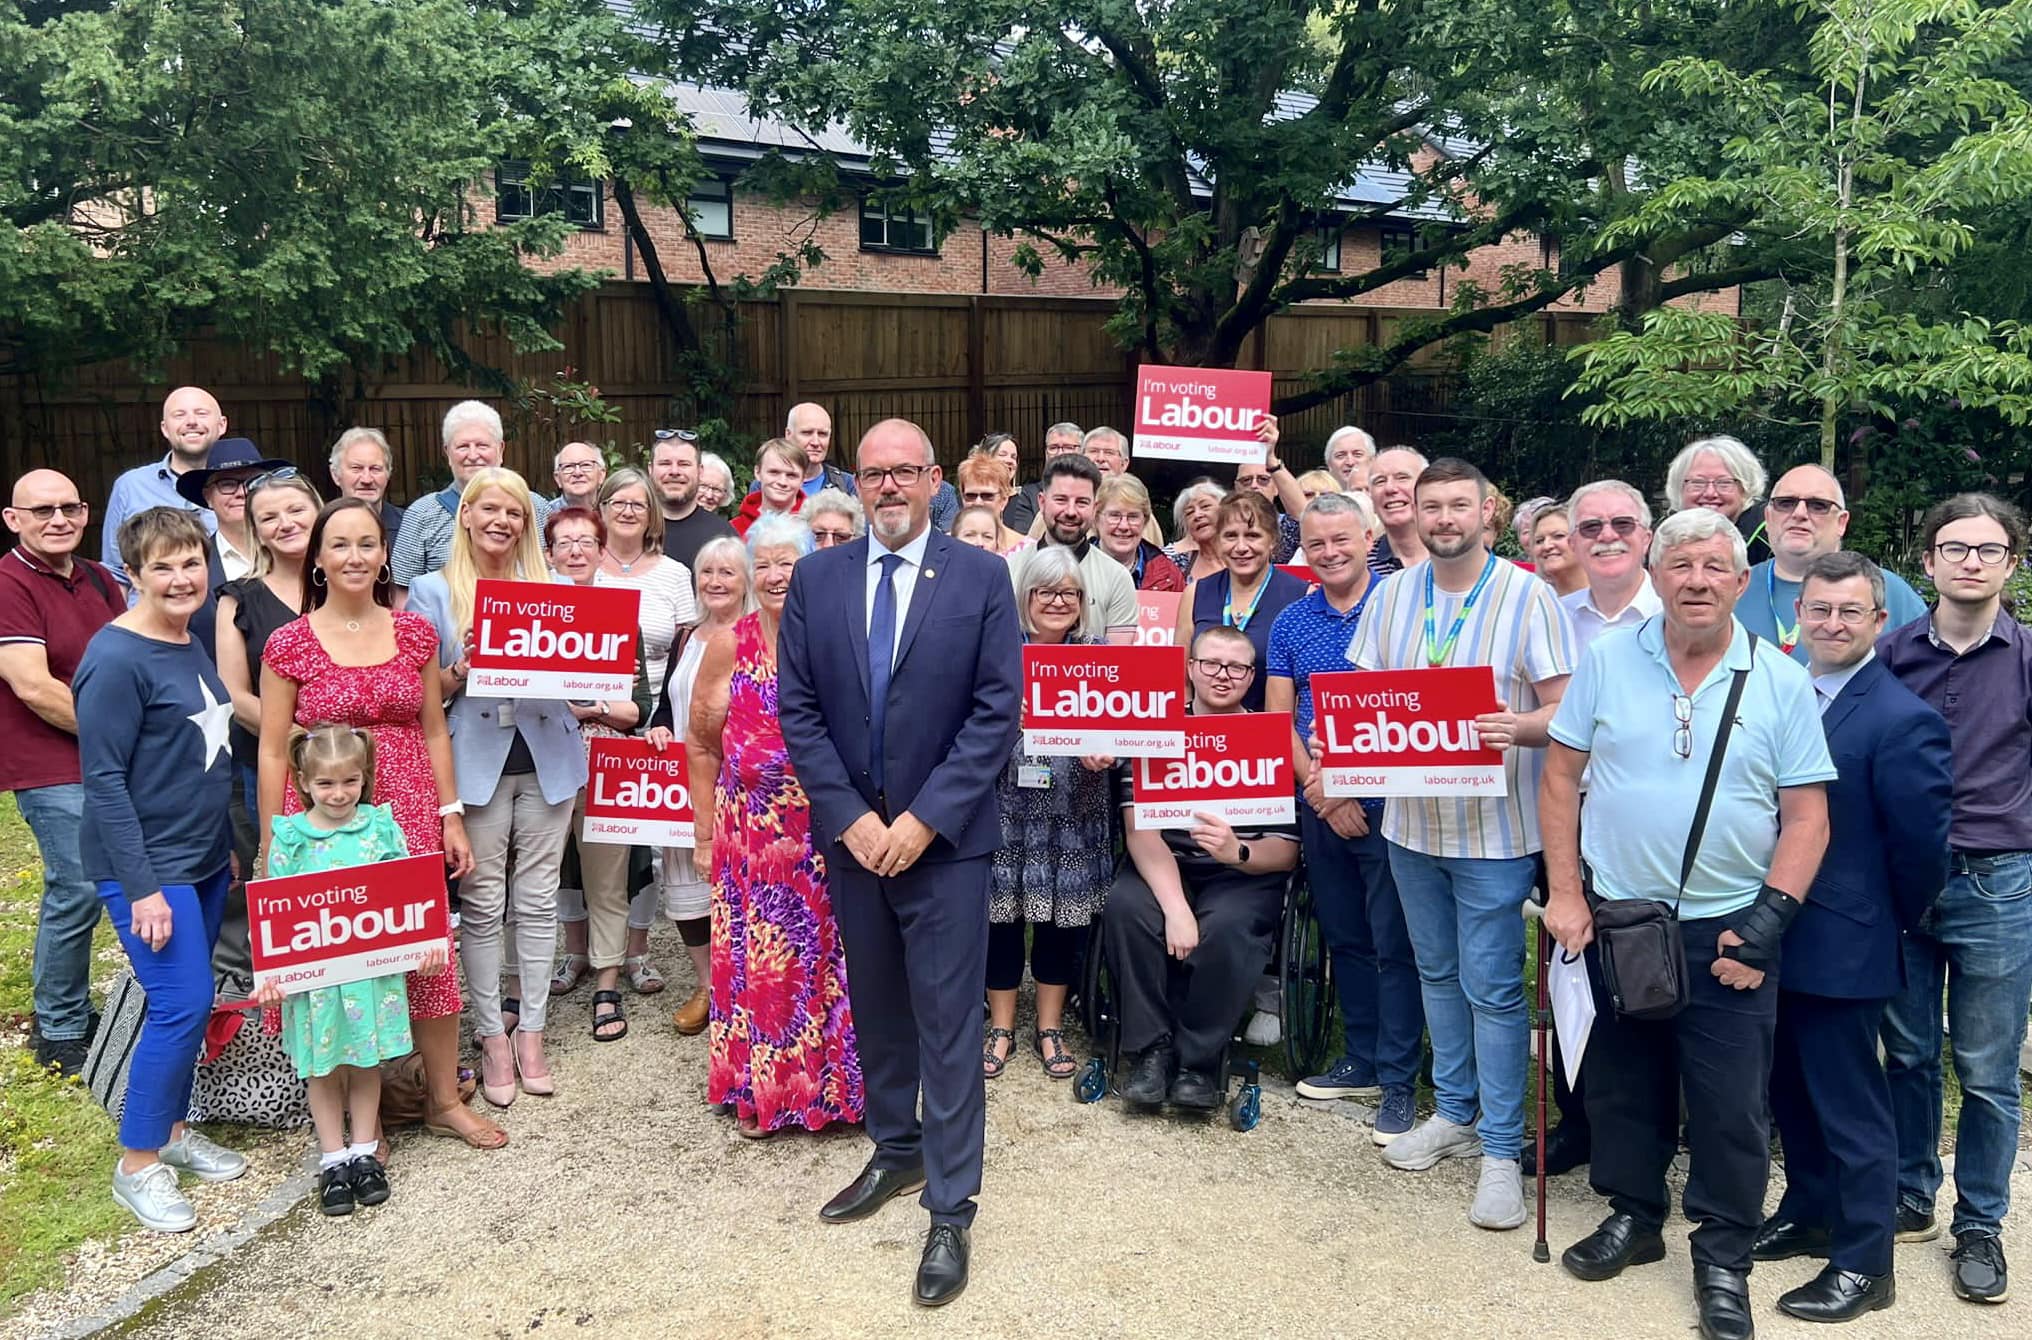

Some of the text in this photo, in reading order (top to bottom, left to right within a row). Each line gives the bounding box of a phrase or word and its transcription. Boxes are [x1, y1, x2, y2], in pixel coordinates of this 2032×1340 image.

[1144, 379, 1216, 400] I'm voting
[1141, 396, 1263, 431] Labour
[1150, 440, 1181, 450] Labour
[483, 597, 575, 623] I'm voting
[480, 619, 629, 661] Labour
[488, 675, 530, 687] Labour
[1031, 661, 1120, 683] I'm voting
[563, 679, 624, 692] labour.org.uk
[1032, 680, 1176, 719] Labour
[1321, 688, 1422, 712] I'm voting
[1042, 735, 1082, 746] Labour
[1114, 738, 1176, 749] labour.org.uk
[1184, 731, 1228, 752] oting
[596, 752, 680, 777] I'm voting
[1140, 751, 1285, 791] Labour
[1343, 775, 1386, 786] Labour
[1424, 774, 1496, 787] labour.org.uk
[594, 772, 694, 811] Labo
[1153, 808, 1192, 819] Labour
[1224, 805, 1286, 818] labour.org.uk
[601, 823, 639, 835] Labour
[258, 885, 369, 916] I'm voting
[260, 899, 436, 958] Labour
[277, 966, 327, 986] Labour
